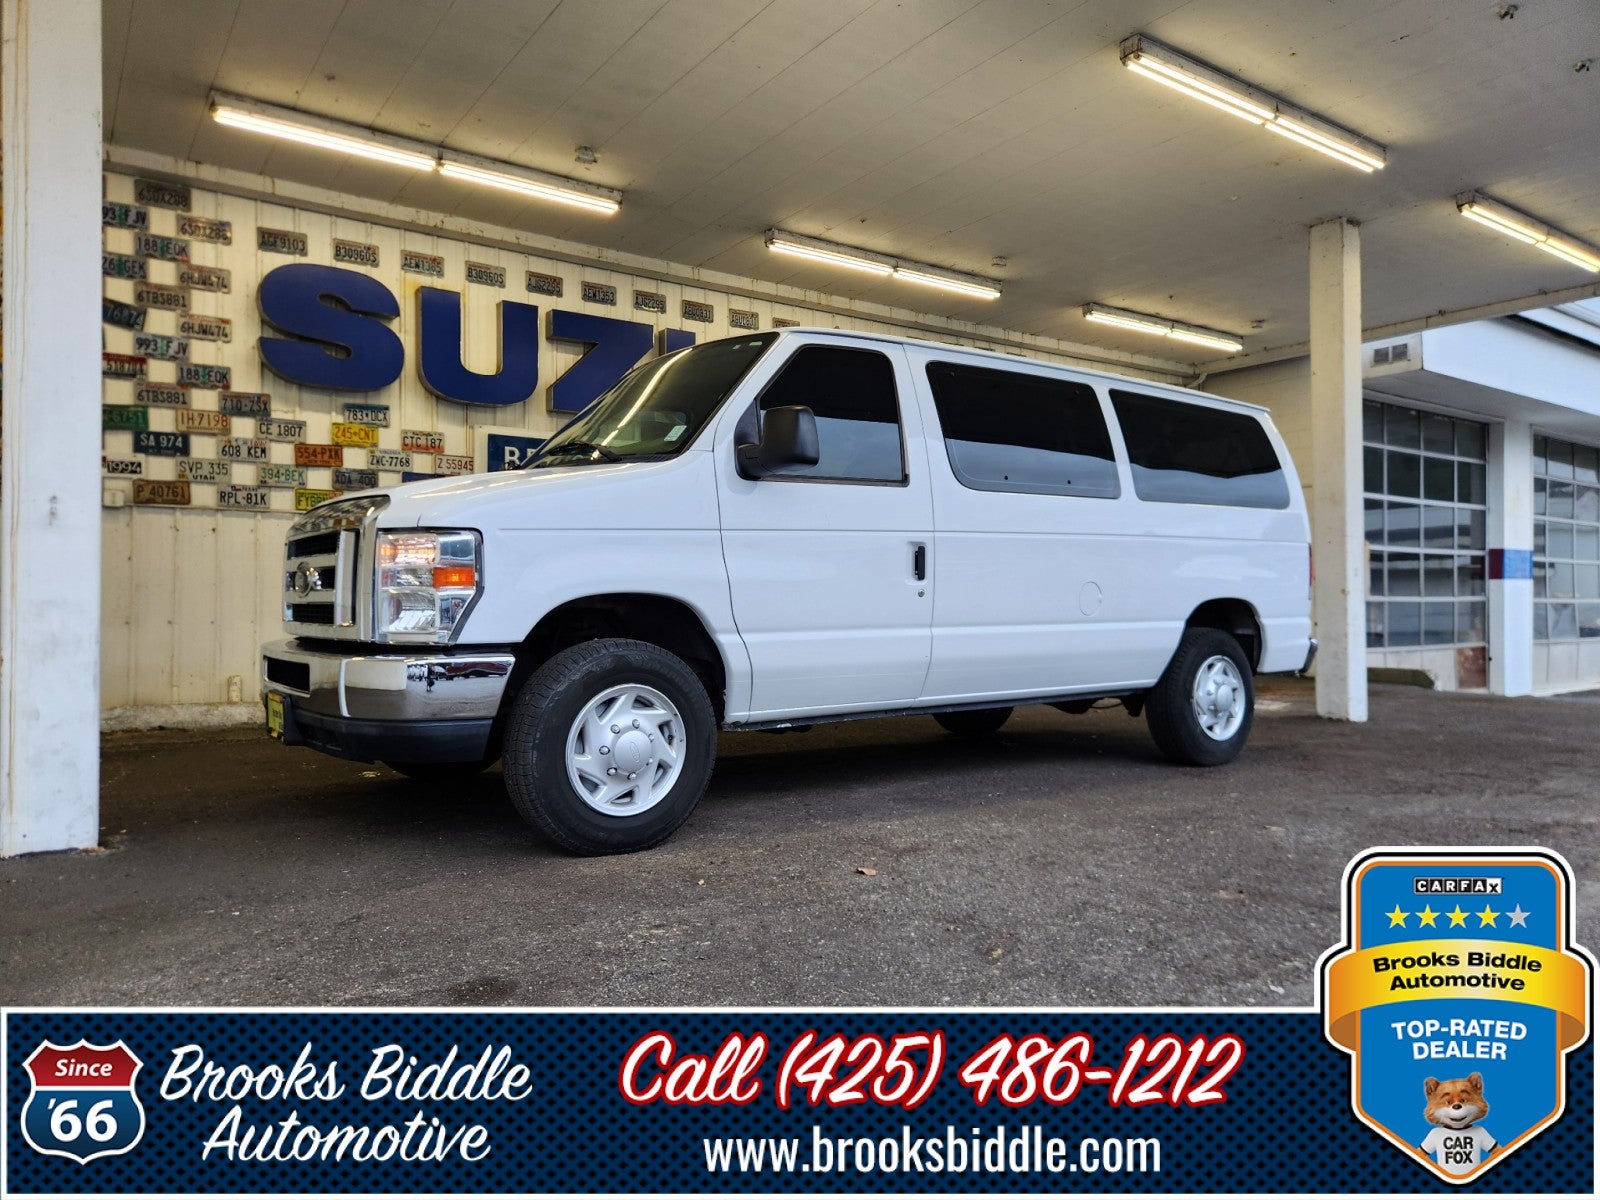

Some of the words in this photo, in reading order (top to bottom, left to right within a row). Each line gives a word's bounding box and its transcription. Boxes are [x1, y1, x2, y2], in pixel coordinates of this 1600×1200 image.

[257, 262, 698, 413] SUZ
[259, 422, 273, 437] CE
[277, 424, 303, 438] 1807
[139, 433, 156, 448] SA
[161, 435, 183, 448] 974
[402, 433, 422, 448] CTC
[425, 435, 443, 450] 187
[221, 444, 241, 458] 608
[107, 461, 141, 474] 1994
[179, 460, 203, 475] SVP
[209, 462, 229, 476] 335
[437, 456, 445, 469] Z
[446, 457, 474, 472] 55945
